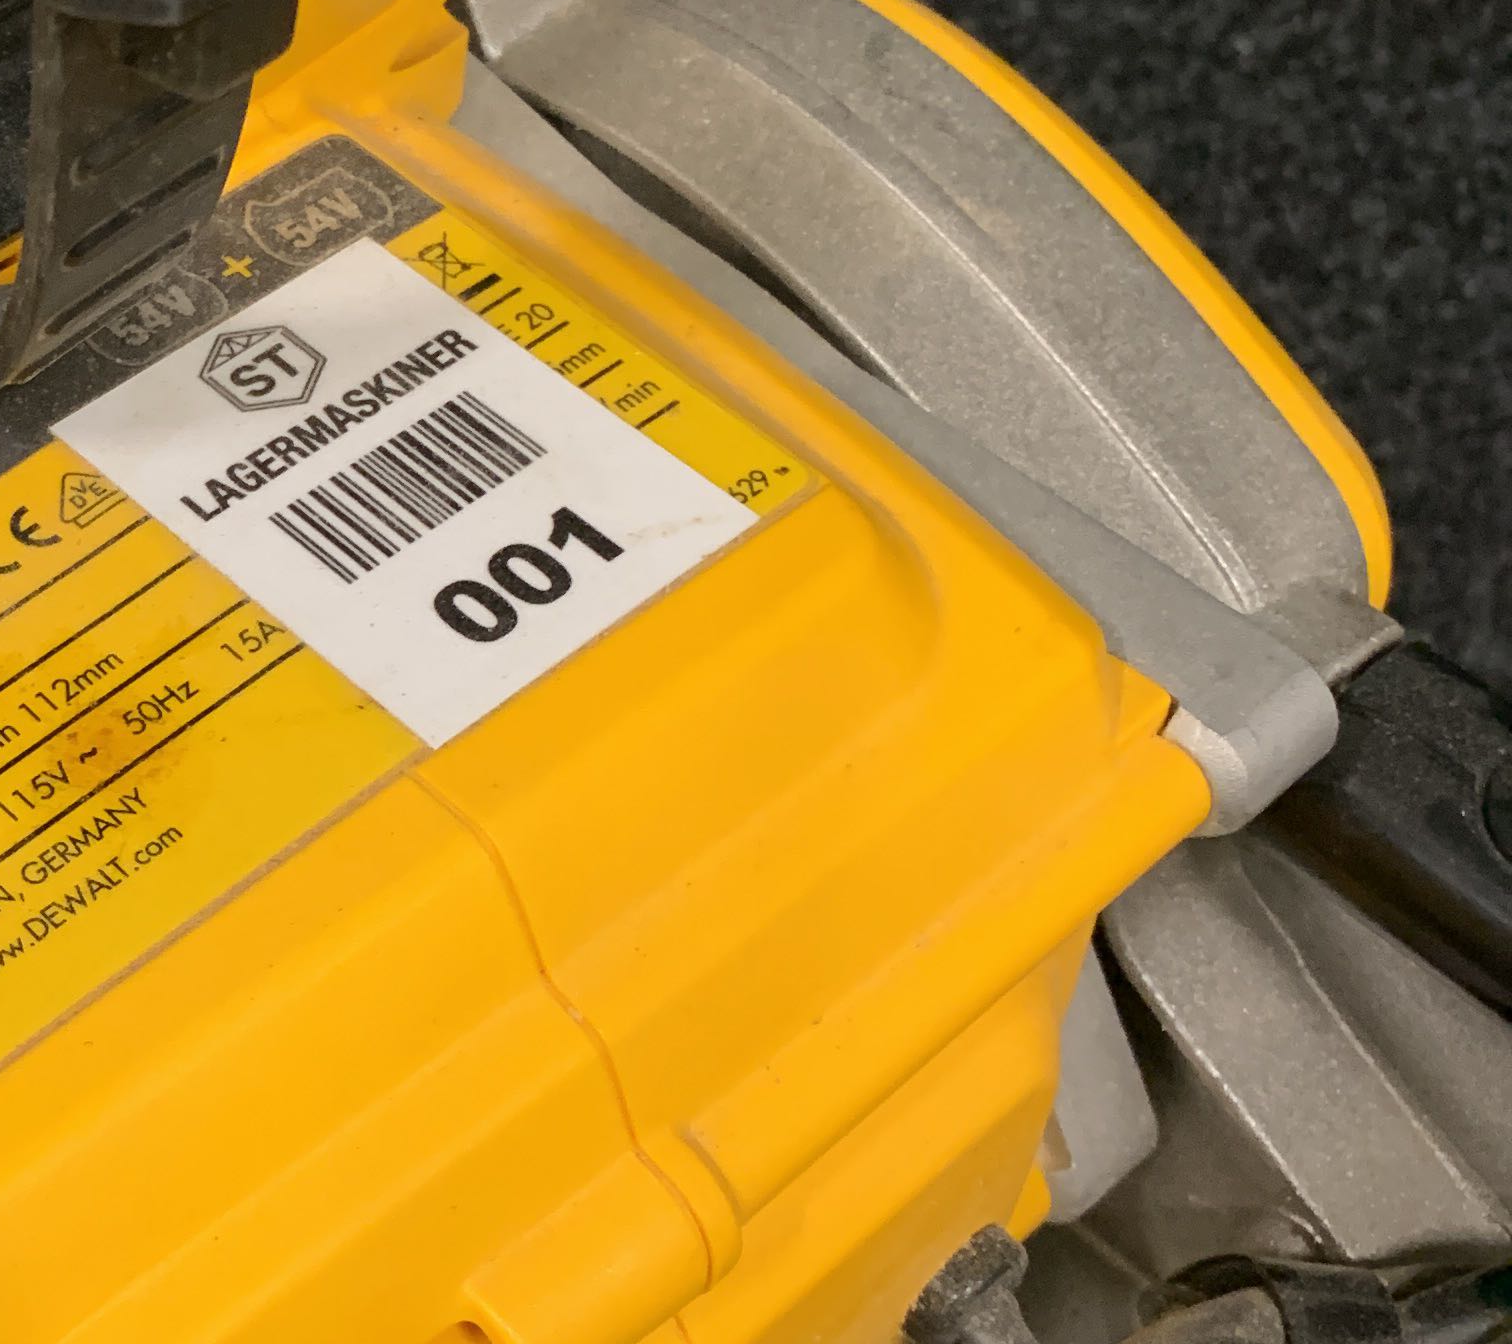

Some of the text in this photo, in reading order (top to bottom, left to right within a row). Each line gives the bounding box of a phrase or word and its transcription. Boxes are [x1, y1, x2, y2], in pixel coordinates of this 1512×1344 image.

[272, 188, 363, 249] 54V
[515, 303, 555, 332] 20
[229, 341, 301, 398] ST
[179, 327, 479, 522] LAGERMASKINER
[433, 506, 626, 643] 001
[18, 652, 124, 725] 112mm
[123, 680, 199, 736] 50Hz
[220, 621, 286, 662] 15A
[21, 787, 148, 885] GERMANY
